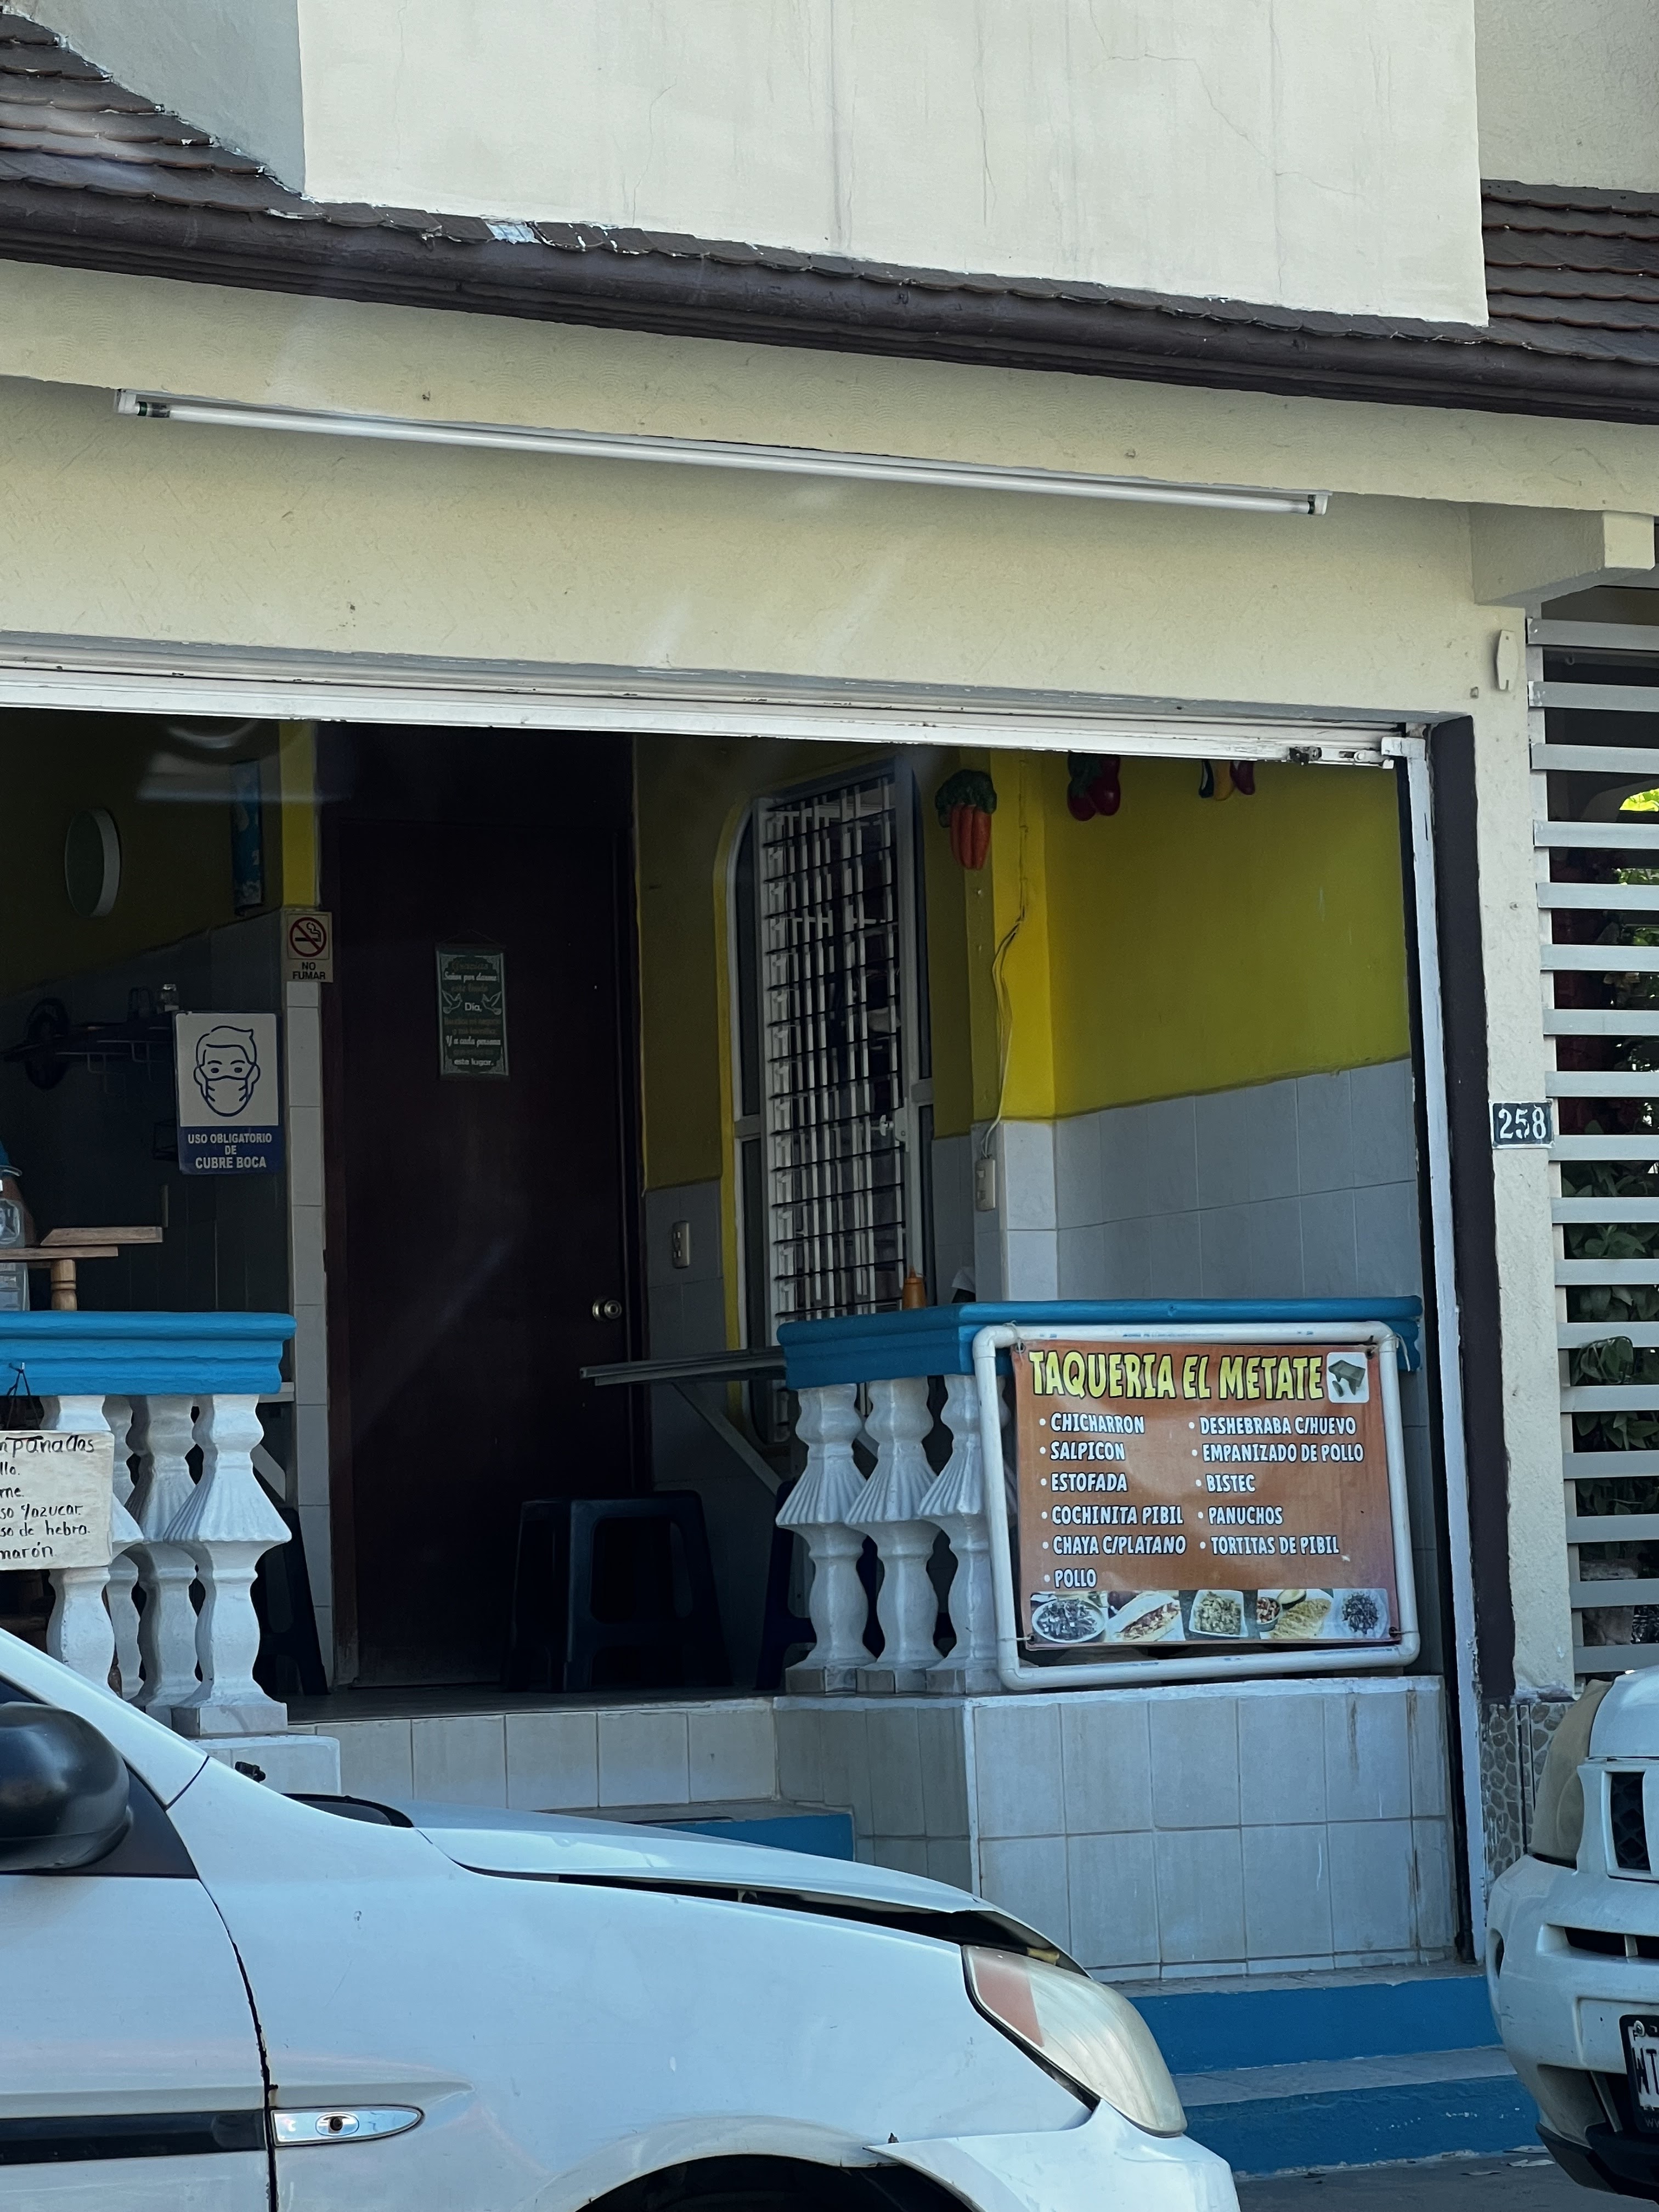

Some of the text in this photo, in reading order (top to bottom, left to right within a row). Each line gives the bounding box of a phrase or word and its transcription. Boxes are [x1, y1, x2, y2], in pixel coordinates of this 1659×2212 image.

[292, 971, 325, 979] FUMAR
[302, 962, 316, 970] NO
[1498, 1105, 1546, 1139] 258
[188, 1133, 272, 1144] USO OBLIGATORIO
[225, 1145, 237, 1155] DE
[195, 1156, 267, 1169] CUBRE BOCA
[1029, 1351, 1324, 1400] TAQUERIA EL METATE
[1051, 1413, 1144, 1434] CHICHARRON
[1199, 1416, 1357, 1435] DESHEBRABA C/HUEVO
[1050, 1441, 1125, 1462] SALPICON
[1202, 1443, 1364, 1462] EMPANIZADO DE POLLO
[1051, 1472, 1128, 1492] ESTOFADA
[1205, 1474, 1256, 1492] BISTEC
[1051, 1505, 1184, 1525] COCHINITA PIBIL
[1208, 1506, 1283, 1525] PANUCHOS
[19, 1522, 34, 1536] de
[1053, 1534, 1187, 1554] CHAYA C/PLATANO
[1210, 1535, 1340, 1555] TORTITAS DE PIBIL
[1054, 1568, 1097, 1588] POLLO
